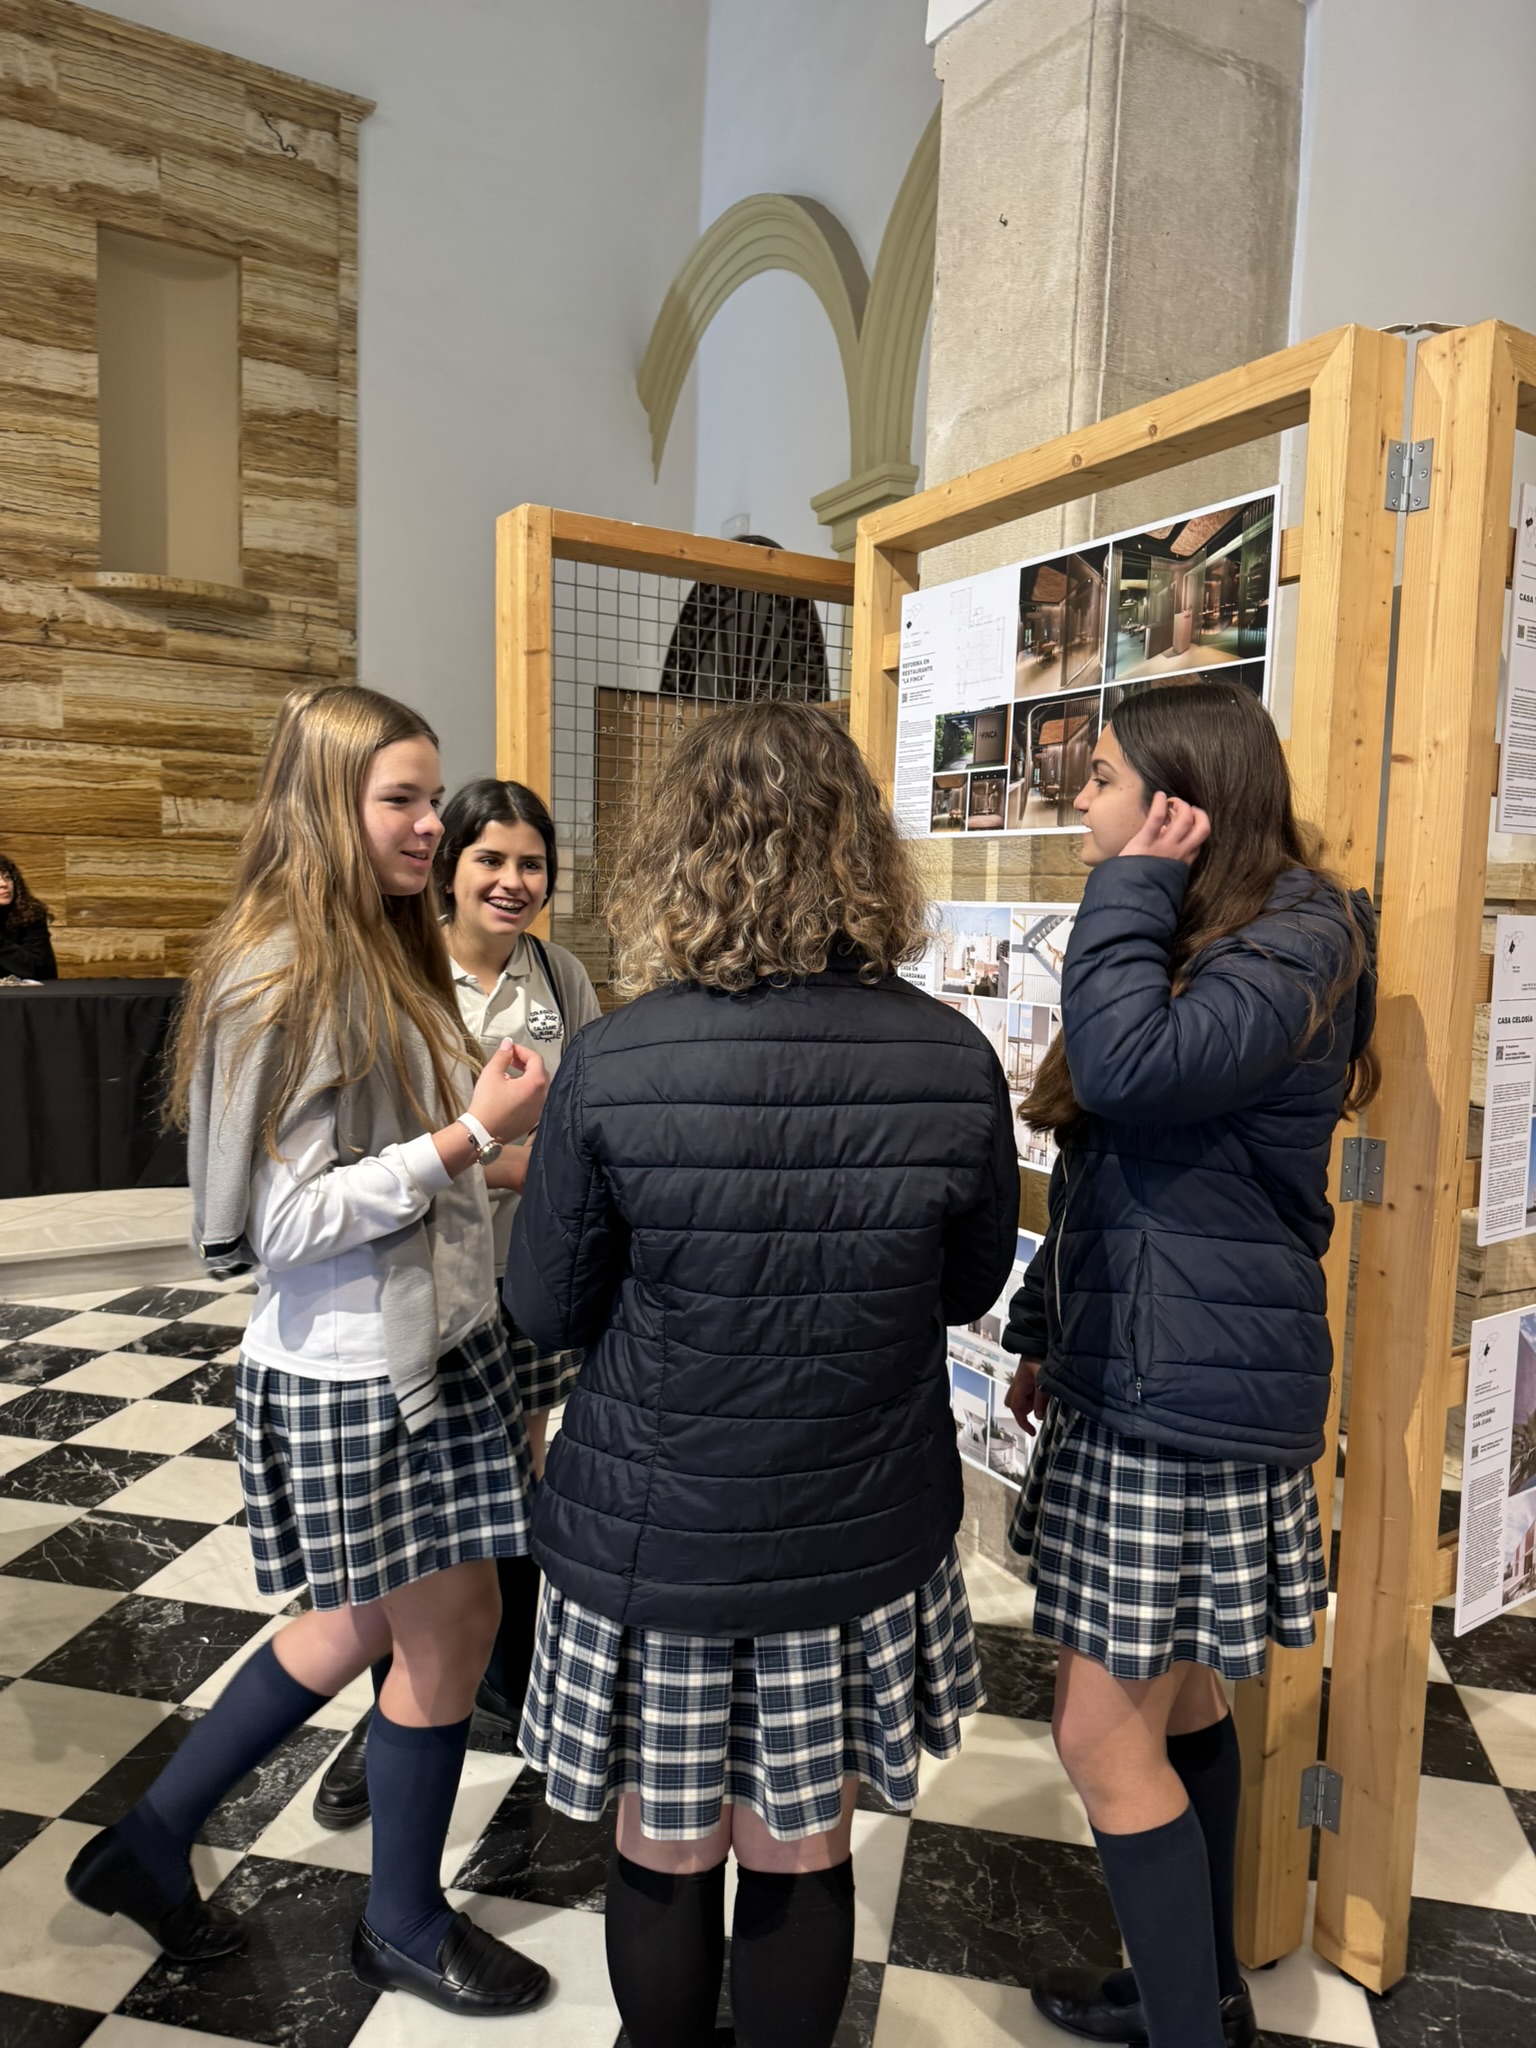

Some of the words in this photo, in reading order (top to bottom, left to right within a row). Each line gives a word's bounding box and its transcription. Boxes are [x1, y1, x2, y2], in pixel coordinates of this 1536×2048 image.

[1519, 593, 1534, 604] CASA
[902, 660, 922, 668] REFORMA
[902, 665, 933, 676] RESTAURANTE
[1498, 1016, 1511, 1025] CASA
[1512, 1014, 1533, 1024] CELOSÍA
[1473, 1407, 1496, 1420] COHOUSING
[1472, 1421, 1481, 1429] SAN
[1481, 1417, 1492, 1426] JUAN
